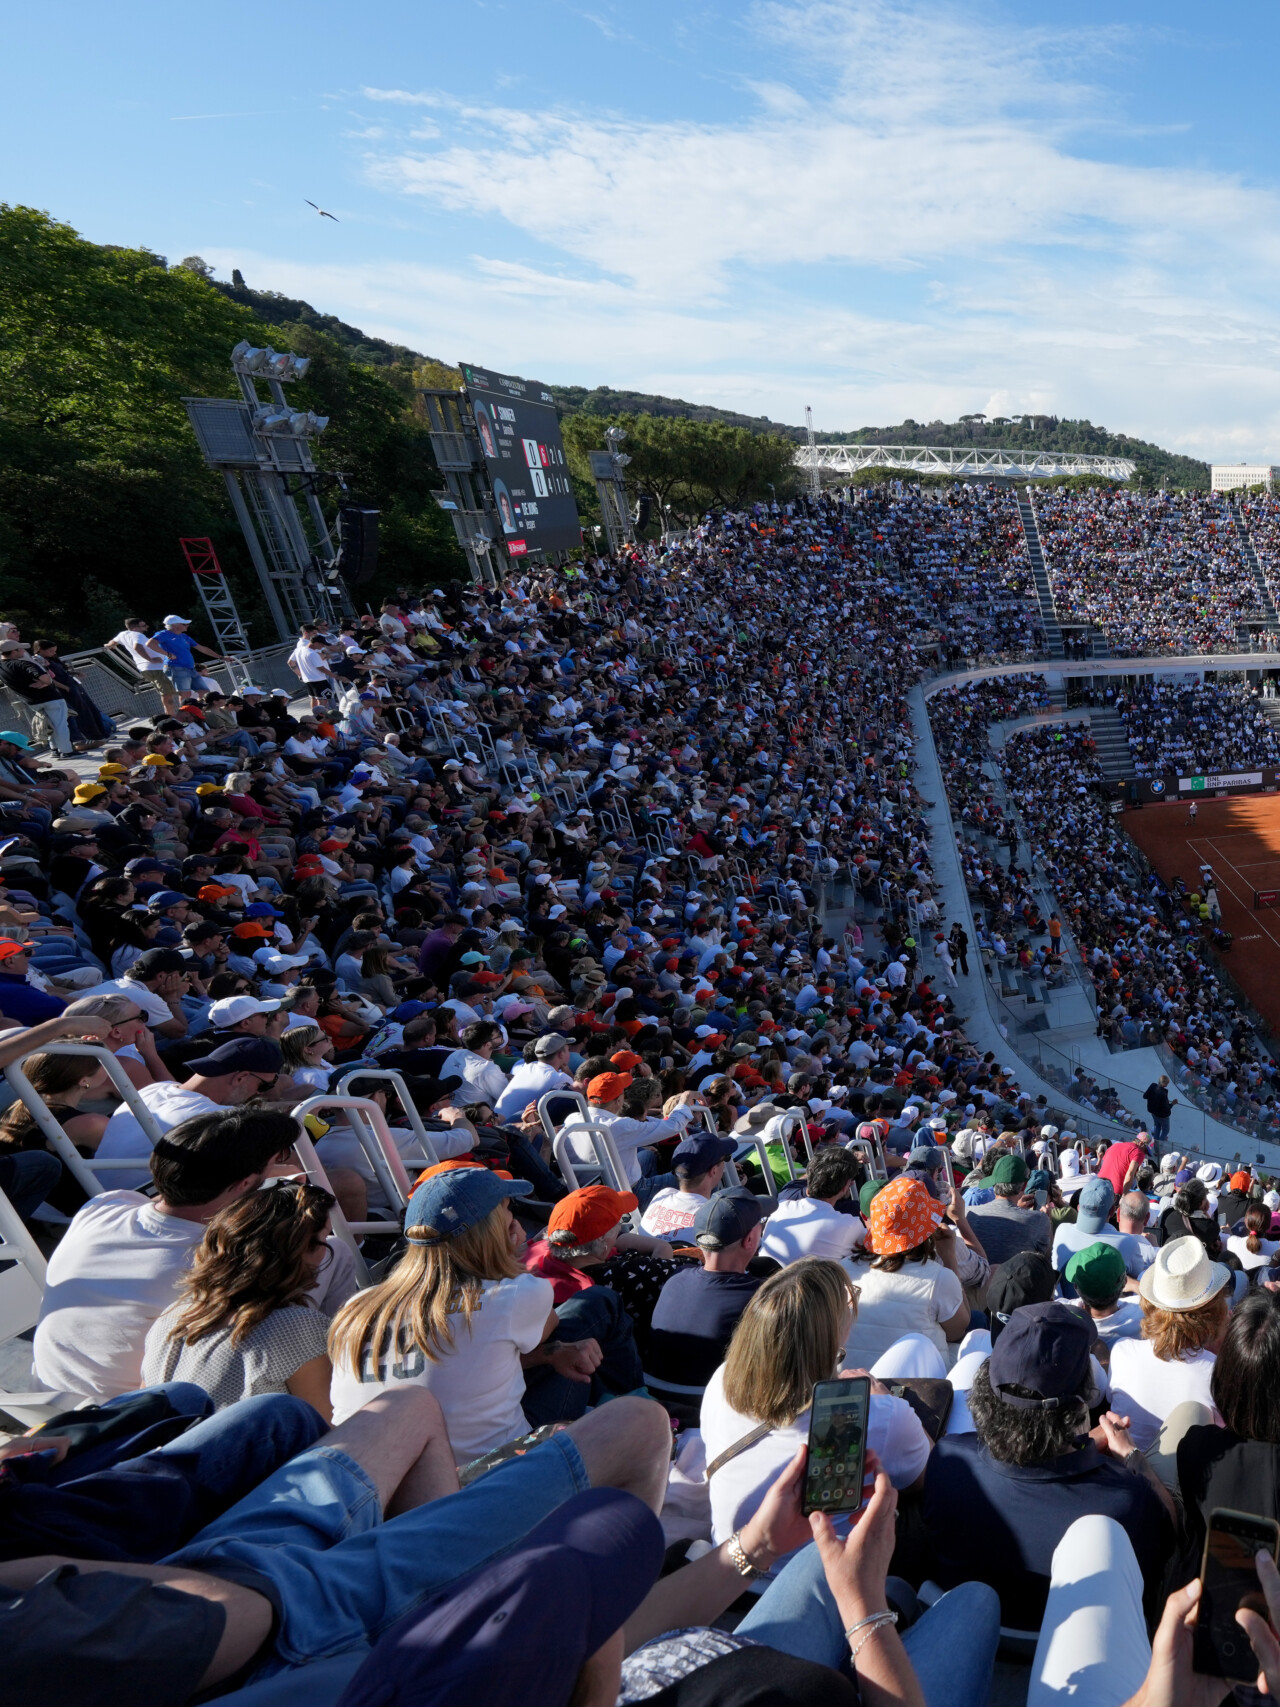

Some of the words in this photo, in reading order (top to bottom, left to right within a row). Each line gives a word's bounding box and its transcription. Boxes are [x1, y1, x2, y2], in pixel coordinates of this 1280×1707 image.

[498, 406, 516, 422] SINNER
[529, 442, 537, 466] 0
[549, 448, 556, 464] 2
[535, 473, 544, 495] 0
